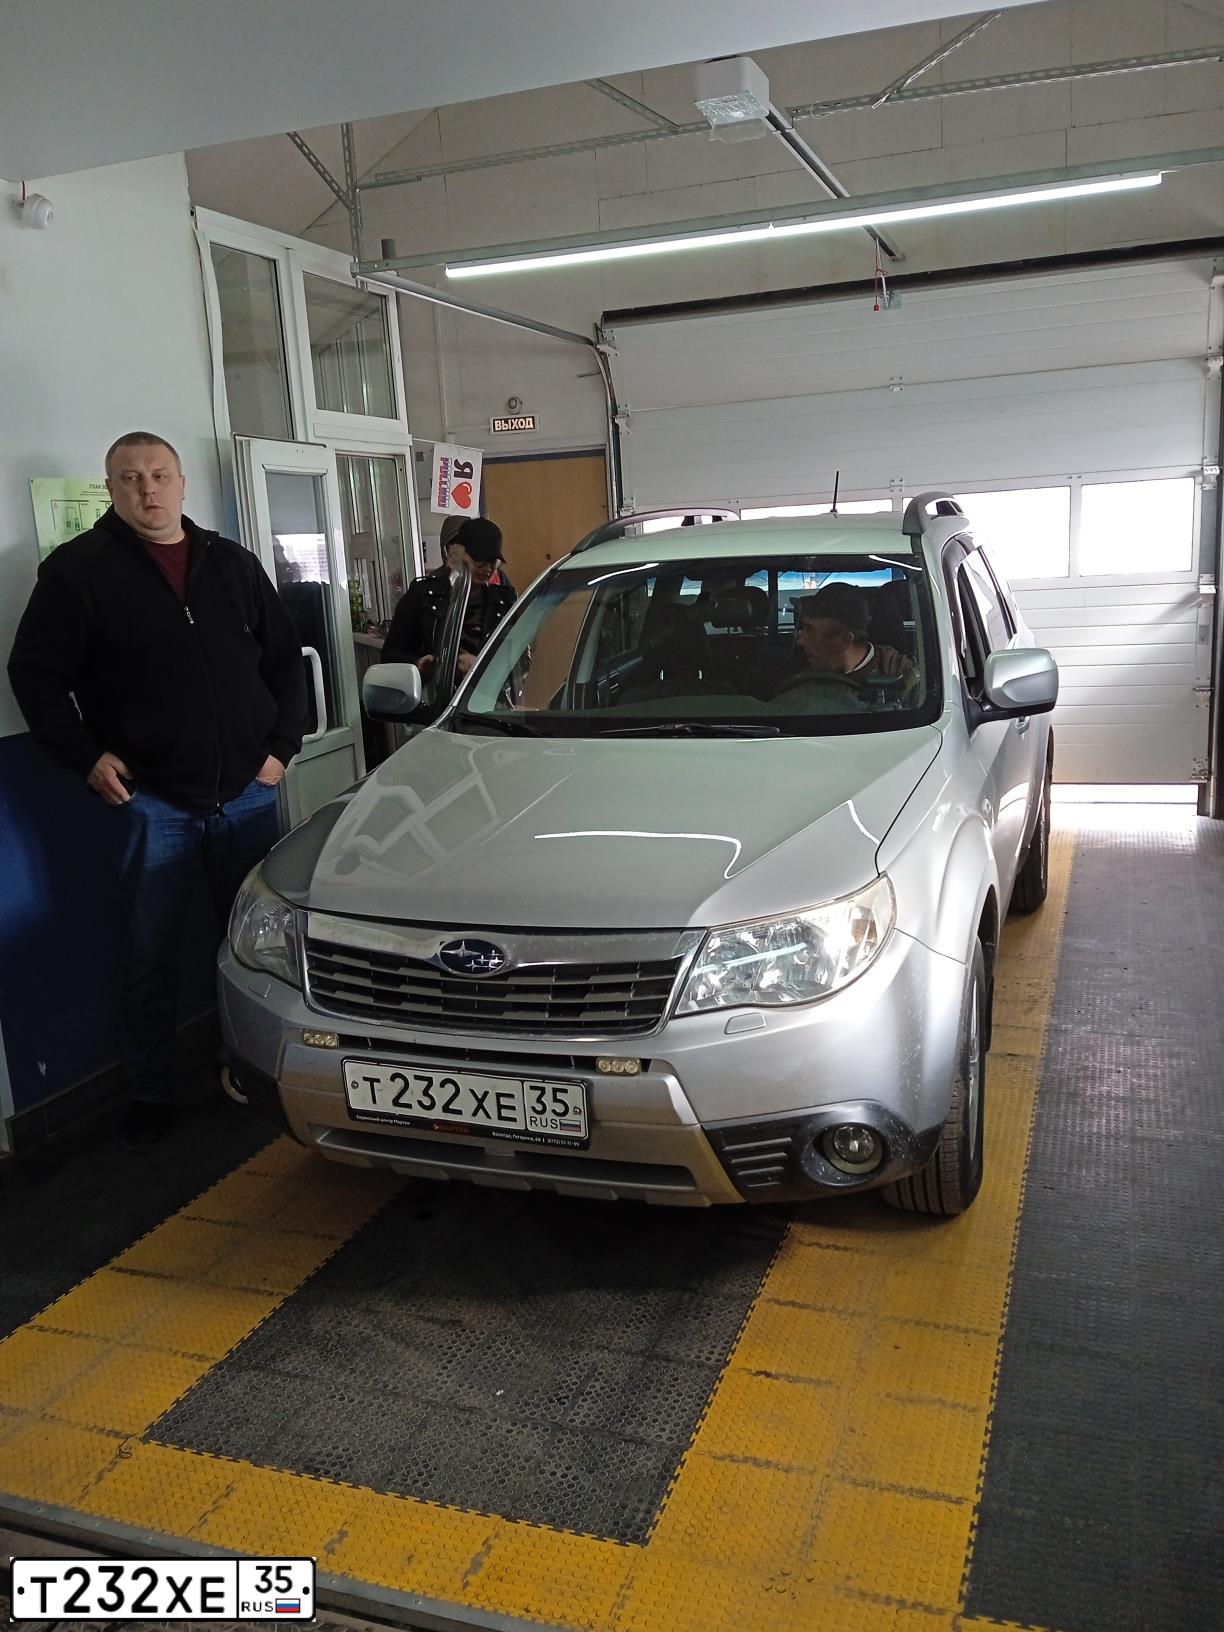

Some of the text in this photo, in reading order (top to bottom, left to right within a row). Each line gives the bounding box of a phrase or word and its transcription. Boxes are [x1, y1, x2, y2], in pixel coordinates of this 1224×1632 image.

[494, 417, 534, 431] ВЫХОД
[453, 458, 474, 479] Я
[362, 1072, 570, 1122] Т232ХЕ 35
[529, 1116, 559, 1130] RUS
